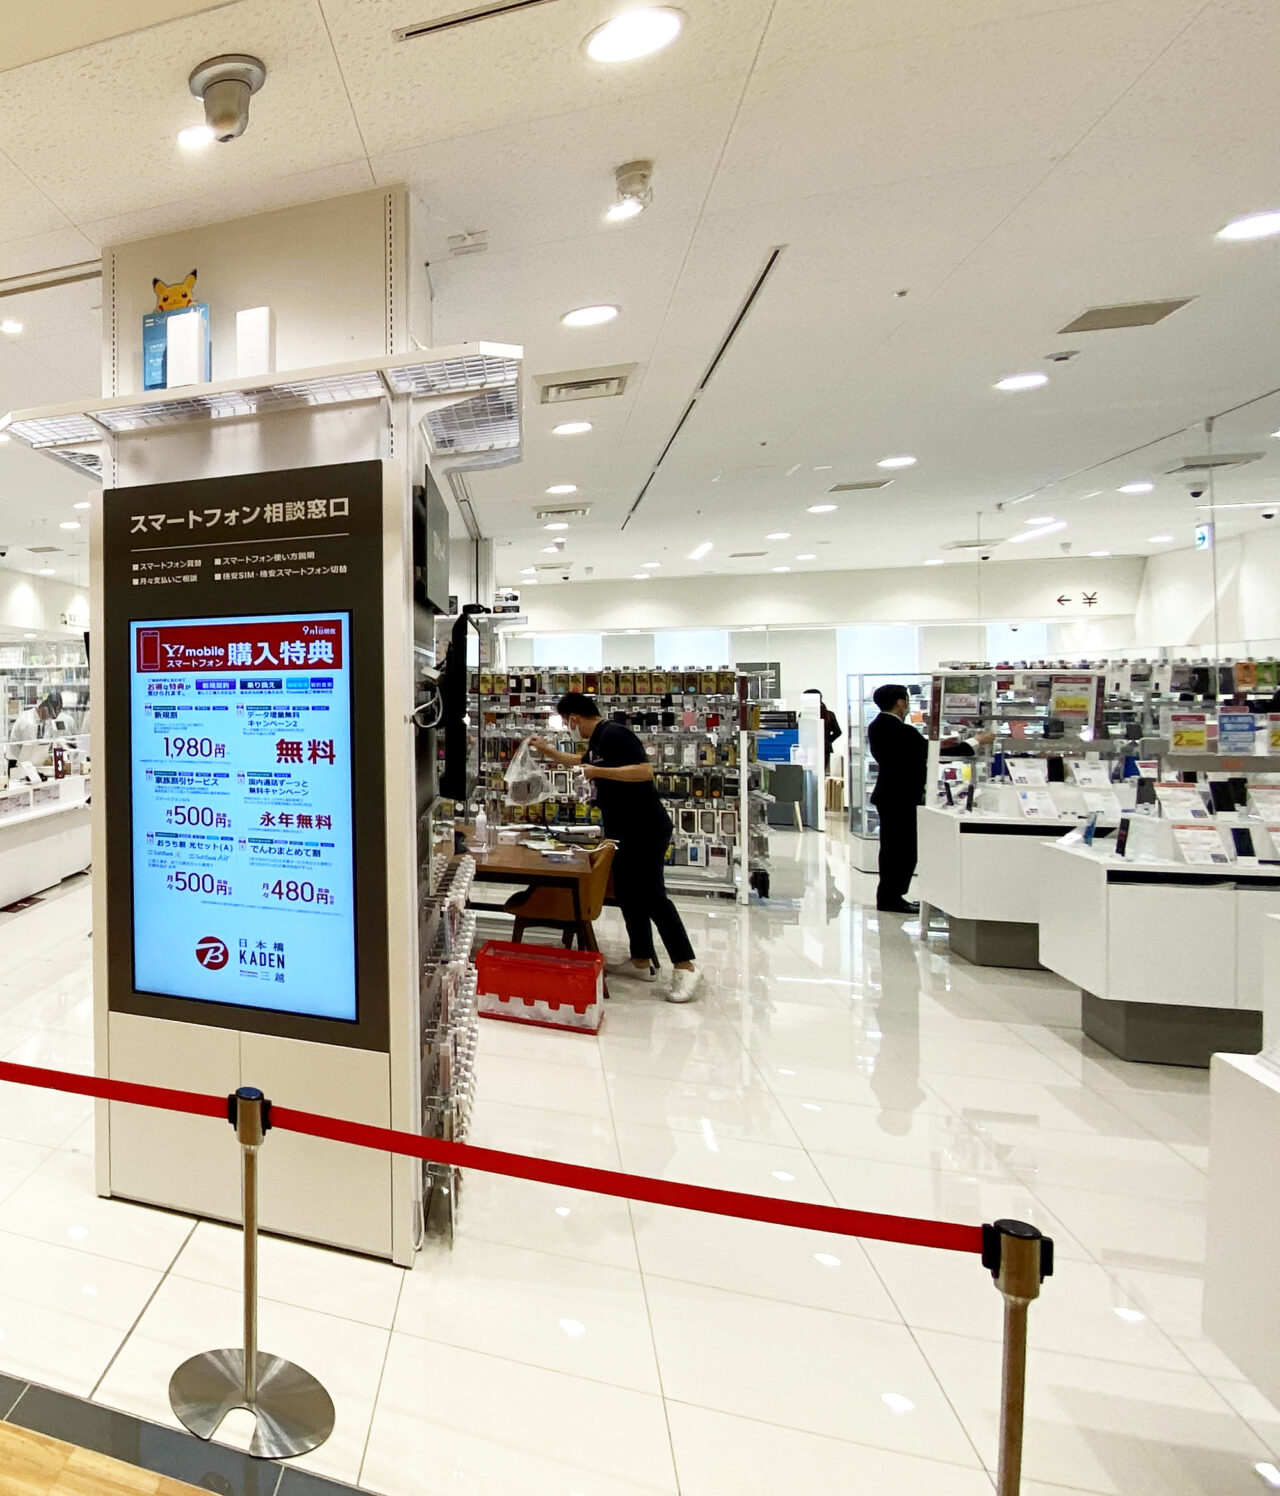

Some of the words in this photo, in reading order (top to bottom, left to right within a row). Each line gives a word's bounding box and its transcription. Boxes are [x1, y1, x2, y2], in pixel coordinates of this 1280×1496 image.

[130, 497, 350, 534] スマートフォン相談窓口
[166, 659, 224, 668] スマートフォン
[226, 640, 335, 667] 購入特典
[275, 738, 336, 765] 無料
[259, 811, 332, 830] 永年無料
[239, 950, 285, 969] KADEN
